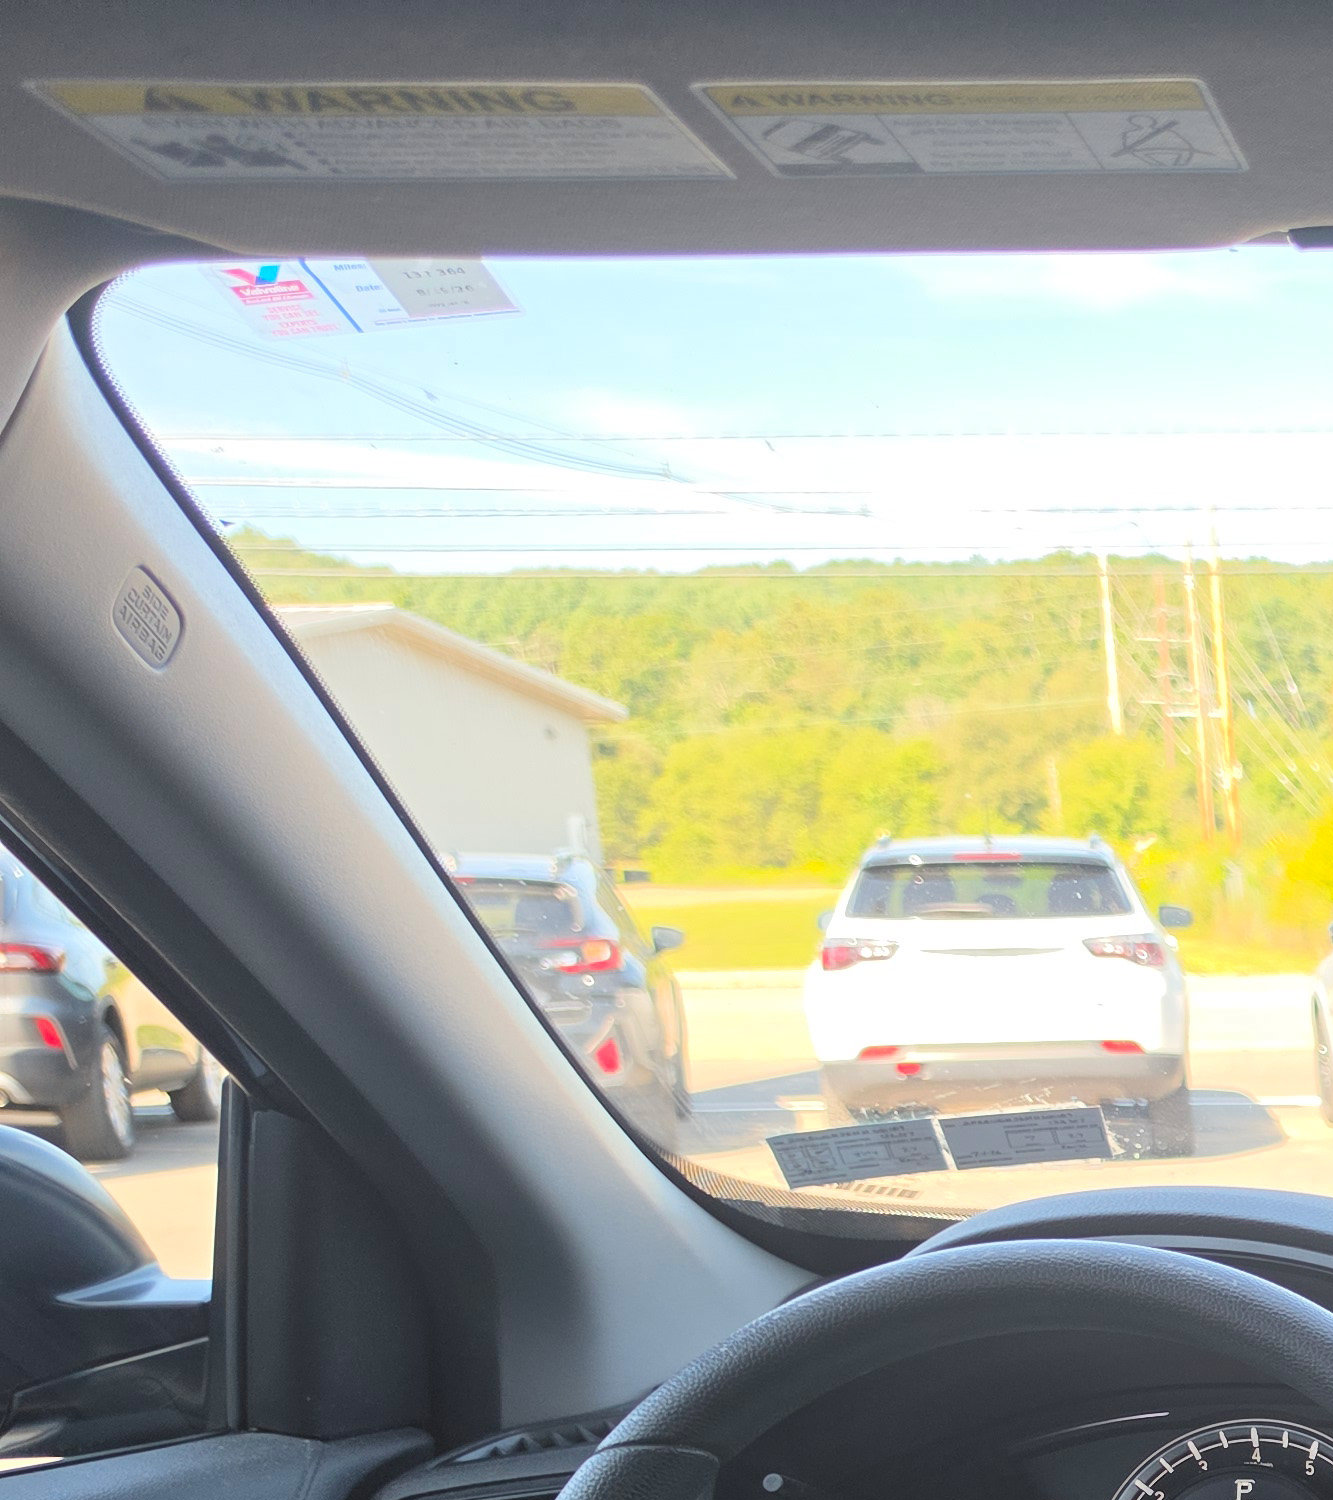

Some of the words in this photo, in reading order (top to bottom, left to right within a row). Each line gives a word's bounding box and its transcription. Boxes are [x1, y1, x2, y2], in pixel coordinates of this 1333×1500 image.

[227, 87, 577, 113] WARNING
[1252, 1447, 1262, 1463] 4
[1305, 1460, 1315, 1476] 5
